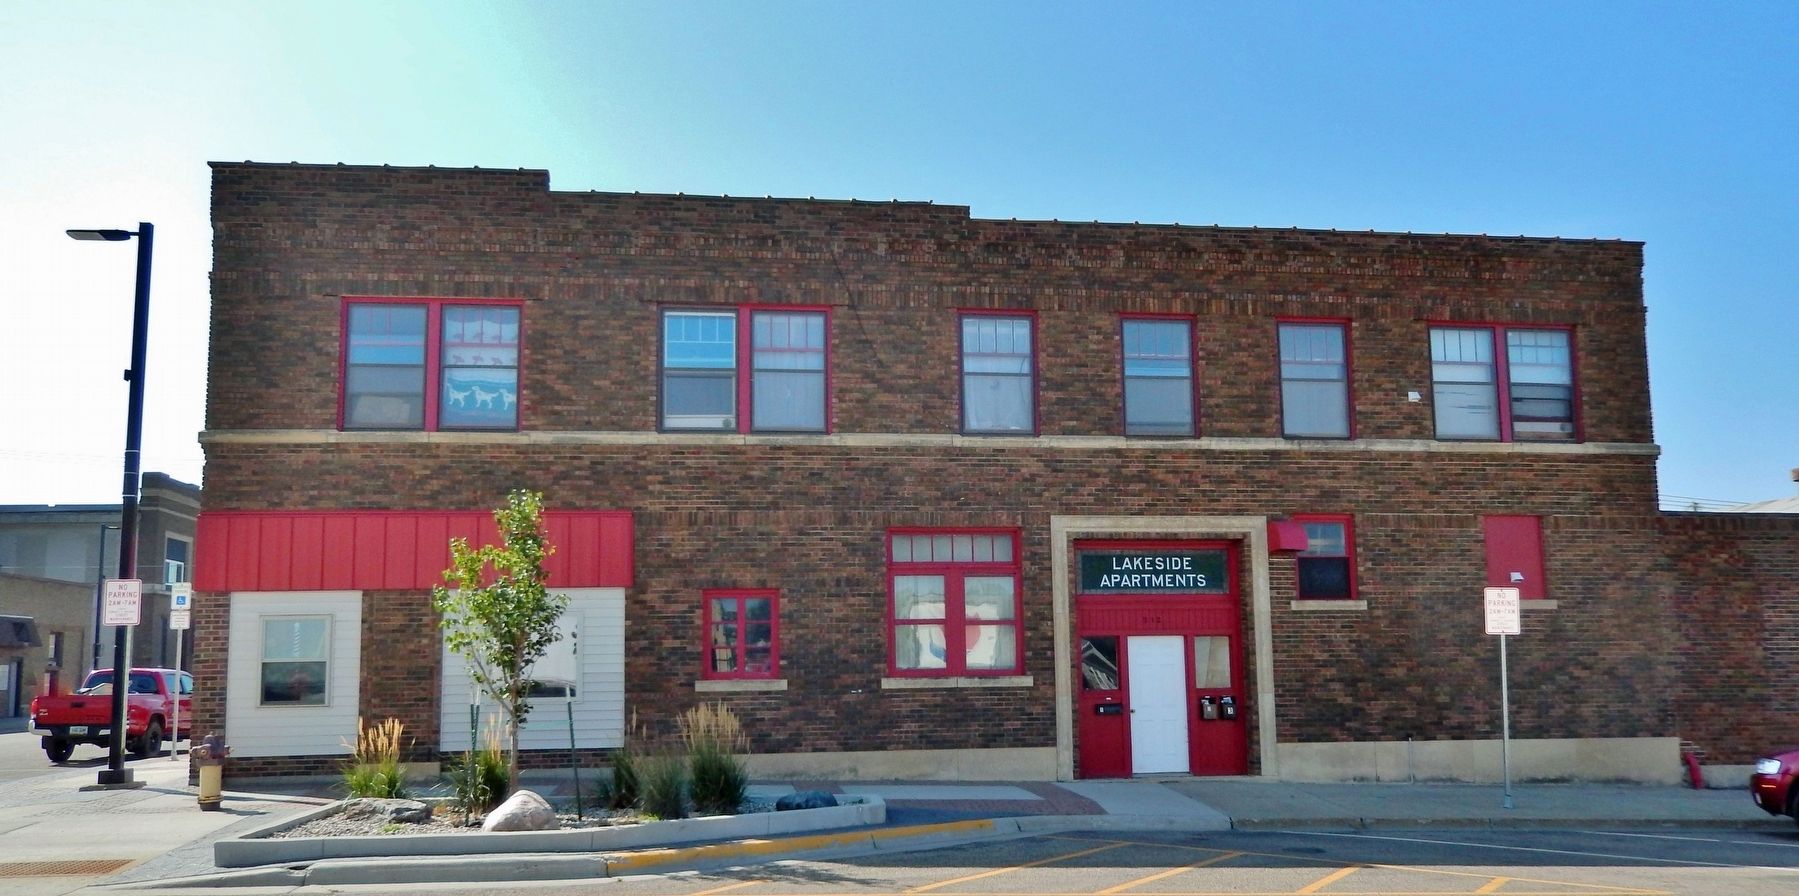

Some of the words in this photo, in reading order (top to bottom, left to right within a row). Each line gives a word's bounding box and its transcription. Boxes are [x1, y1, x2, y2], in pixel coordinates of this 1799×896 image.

[1112, 557, 1192, 570] LAKESIDE
[1100, 574, 1207, 587] APARTMENTS
[108, 591, 137, 599] PARKING
[1488, 599, 1516, 607] PARKING
